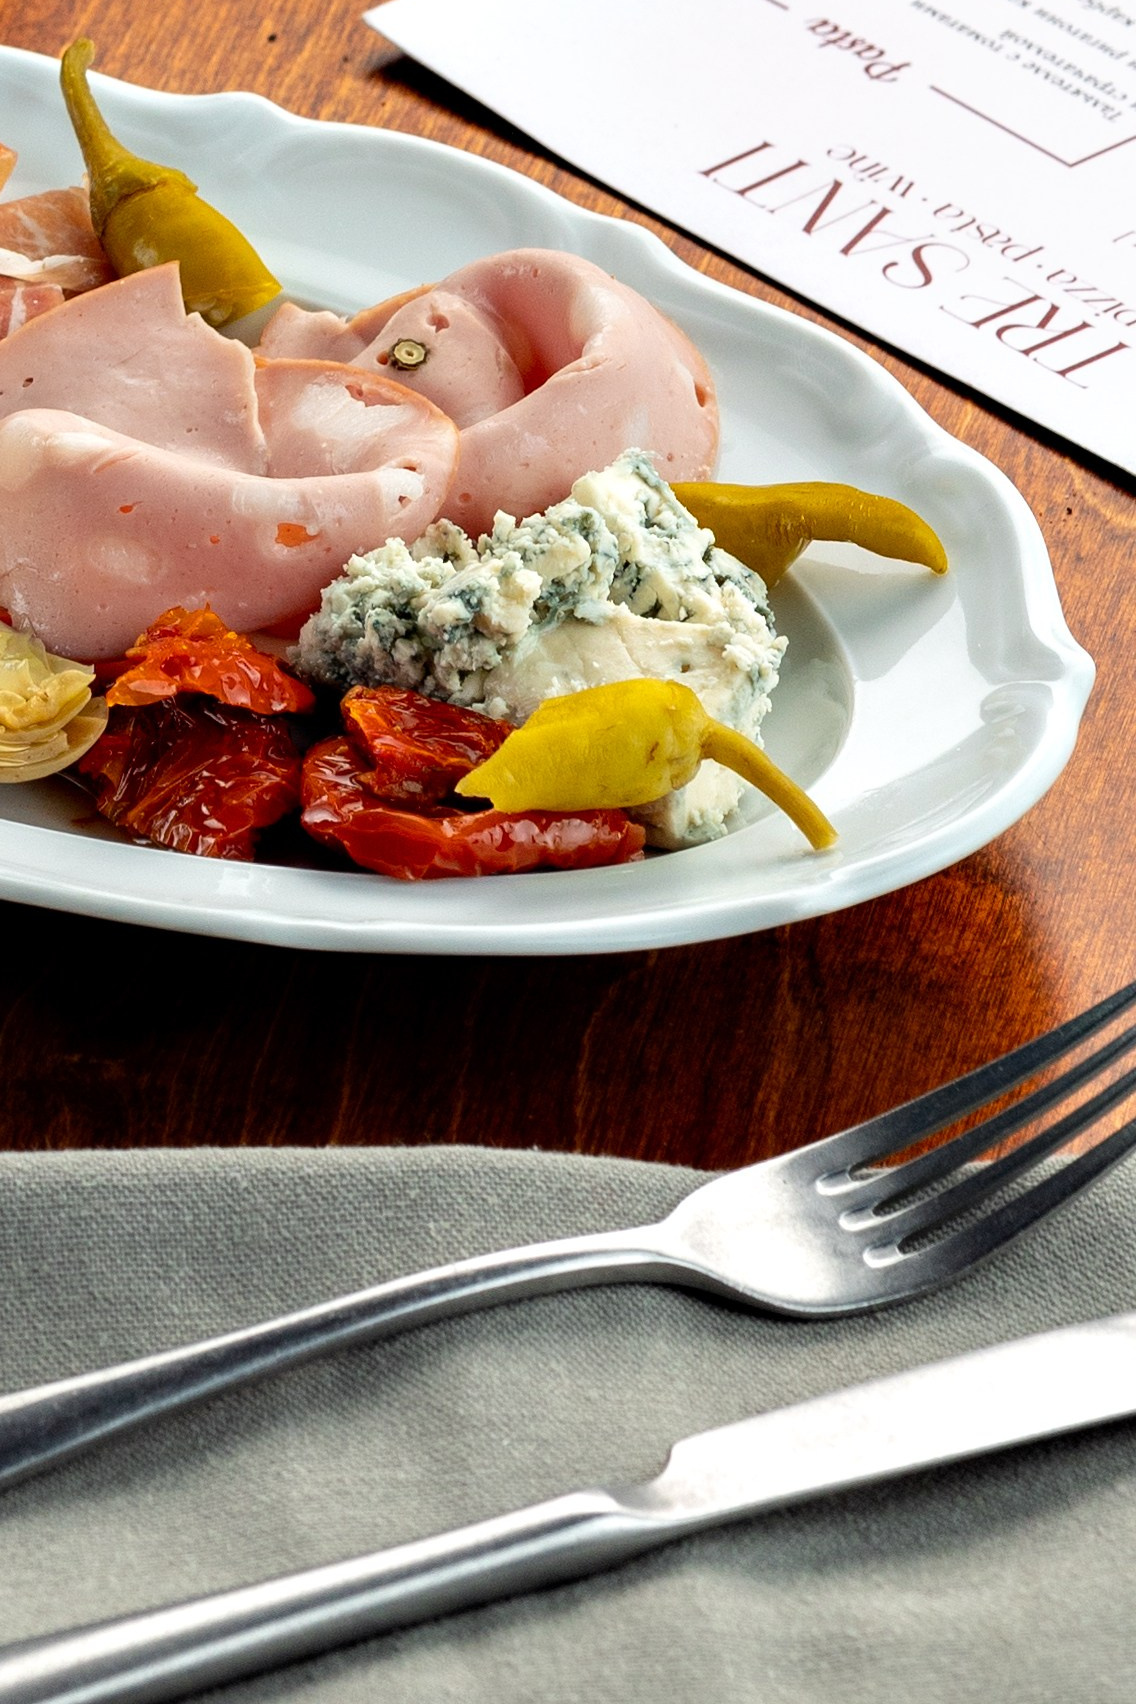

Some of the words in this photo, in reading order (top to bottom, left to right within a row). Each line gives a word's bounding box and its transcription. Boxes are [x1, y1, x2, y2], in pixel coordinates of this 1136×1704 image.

[806, 16, 912, 84] Pasta
[826, 149, 915, 198] wine
[697, 140, 970, 289] SANTI
[933, 203, 1045, 263] pasta
[939, 277, 1131, 389] TRE
